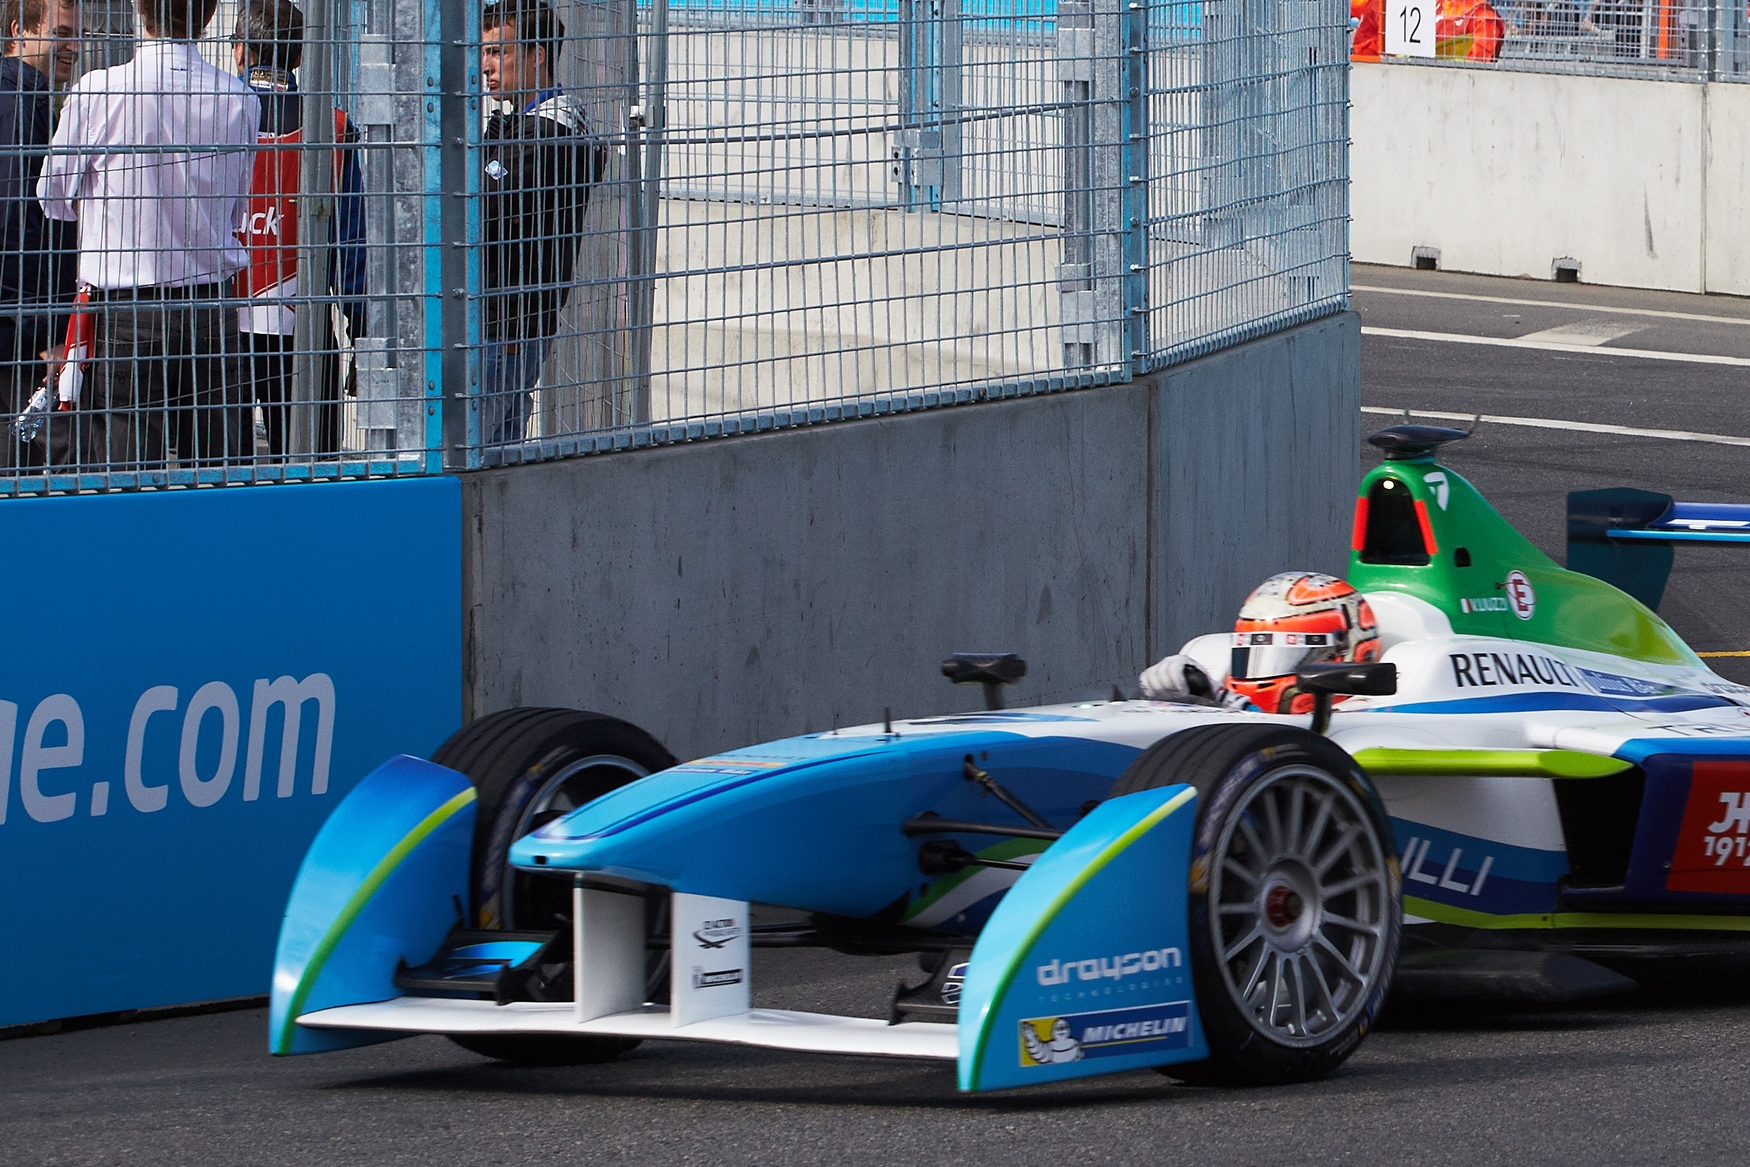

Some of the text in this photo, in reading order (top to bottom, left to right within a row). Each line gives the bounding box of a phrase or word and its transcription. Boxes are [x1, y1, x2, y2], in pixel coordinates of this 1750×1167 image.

[1399, 5, 1422, 44] 12
[1449, 652, 1580, 688] RENAULT
[1036, 946, 1183, 987] drayson
[1082, 1016, 1188, 1044] MICHELIN
